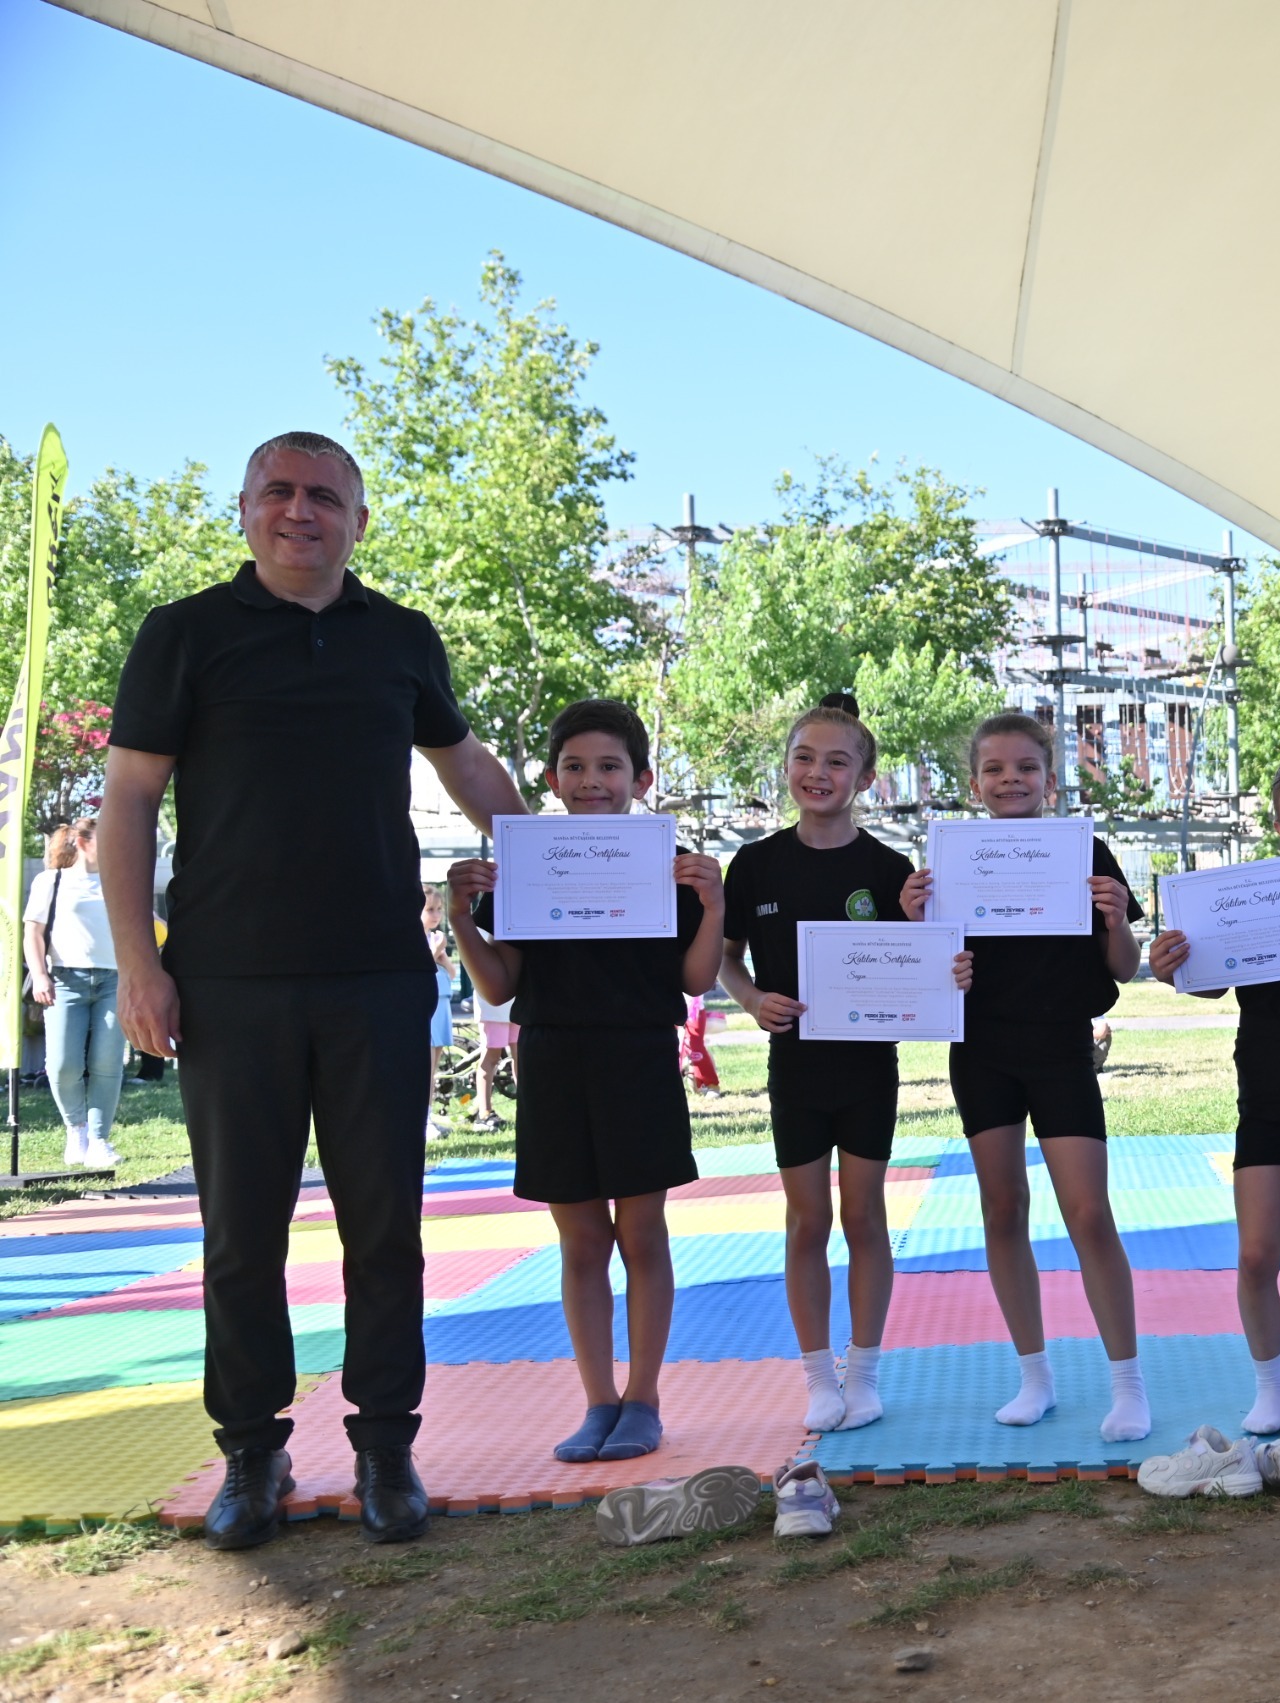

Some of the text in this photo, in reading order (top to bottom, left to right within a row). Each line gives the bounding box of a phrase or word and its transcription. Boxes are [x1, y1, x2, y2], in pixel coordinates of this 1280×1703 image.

[584, 846, 631, 862] Sertifikası
[1008, 847, 1050, 861] Sertifikası
[879, 952, 921, 967] Sertifikası
